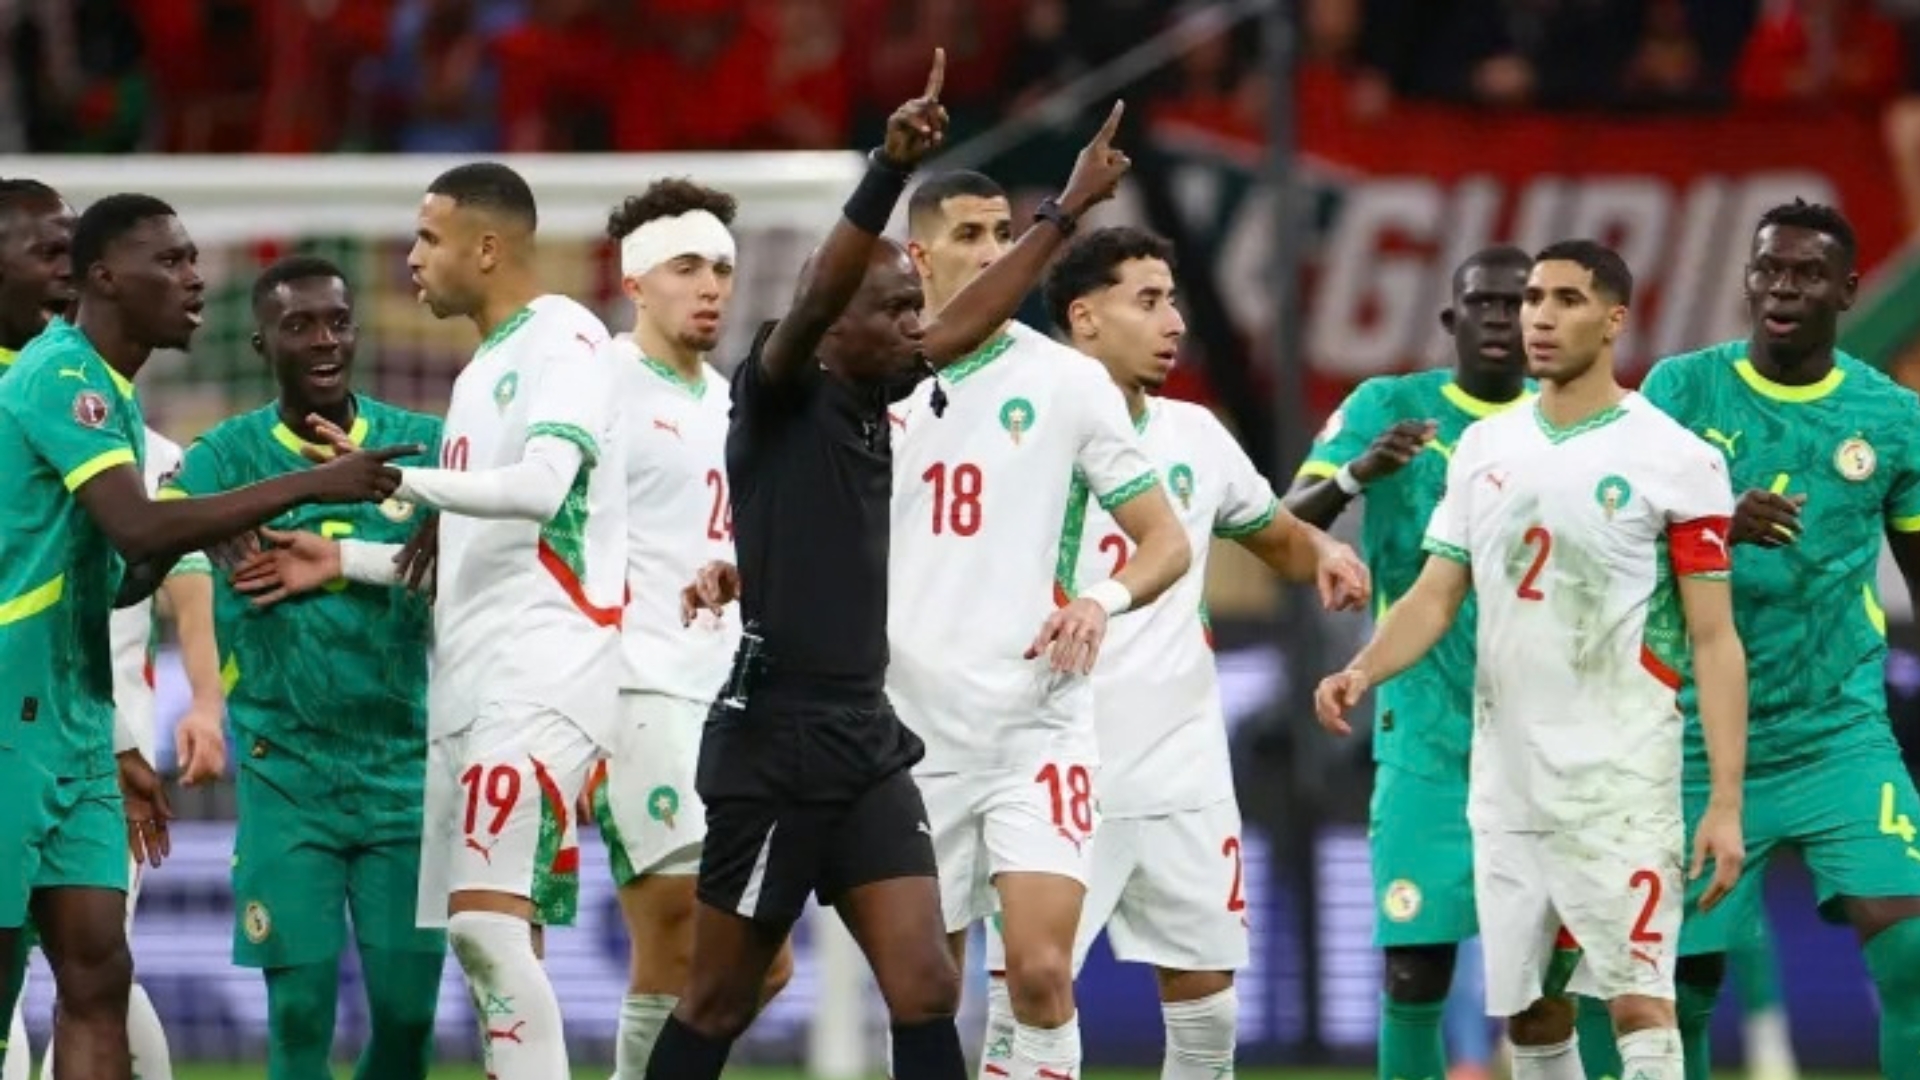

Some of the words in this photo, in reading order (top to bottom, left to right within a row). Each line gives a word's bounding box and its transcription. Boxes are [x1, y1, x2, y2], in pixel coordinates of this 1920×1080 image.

[922, 461, 982, 536] 18
[1517, 527, 1551, 600] 2
[461, 763, 520, 835] 19
[1034, 763, 1092, 832] 18
[1878, 782, 1916, 842] 4
[1629, 869, 1663, 942] 2
